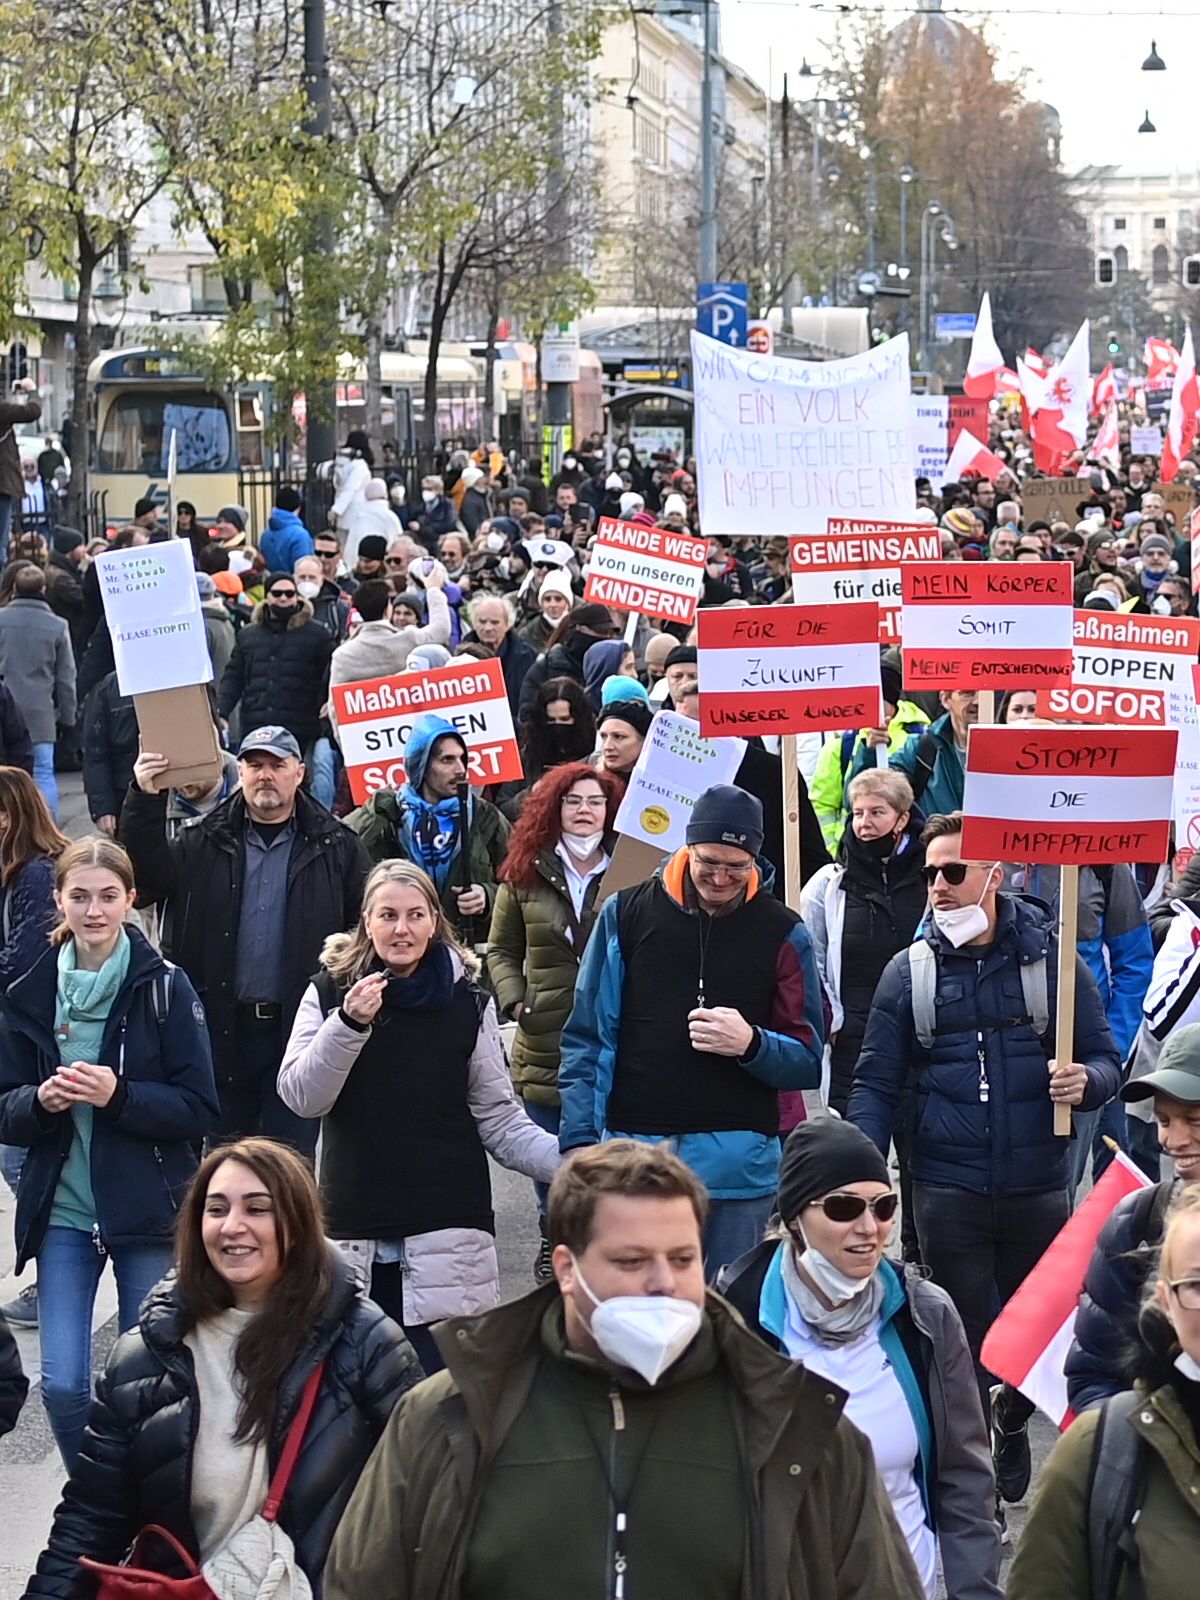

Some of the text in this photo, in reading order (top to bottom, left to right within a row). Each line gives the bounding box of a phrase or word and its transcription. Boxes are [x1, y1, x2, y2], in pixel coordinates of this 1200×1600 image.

[712, 304, 734, 337] P
[738, 387, 870, 424] EIN VOLK
[599, 522, 706, 562] HÄNDE WEG
[793, 536, 938, 565] GEMEINSAM
[121, 558, 152, 569] Soros
[124, 566, 166, 581] Schwab
[598, 556, 695, 588] von unseren
[126, 581, 158, 592] Gates
[589, 577, 691, 619] KINDERN
[833, 578, 902, 599] für die
[912, 574, 969, 596] MEIN
[733, 619, 832, 641] FÜR DIE
[958, 614, 1017, 636] SOMIT
[1073, 616, 1189, 648] aßnahmen
[741, 658, 845, 688] ZUKUNFT
[910, 656, 1071, 677] MEINE ENTSCHEIDUNG
[343, 672, 492, 715] Maßnahmen
[1049, 688, 1166, 720] SOFOR
[710, 702, 865, 726] UNSERER KINDER
[364, 711, 488, 751] STOEN
[670, 744, 702, 763] Gates
[674, 734, 717, 758] Schwab
[1015, 742, 1131, 771] STOPPT
[363, 746, 503, 795] SORT
[637, 778, 694, 807] PLEASE STO
[1049, 791, 1089, 809] DIE
[1002, 831, 1148, 855] IMPFPFLICHT
